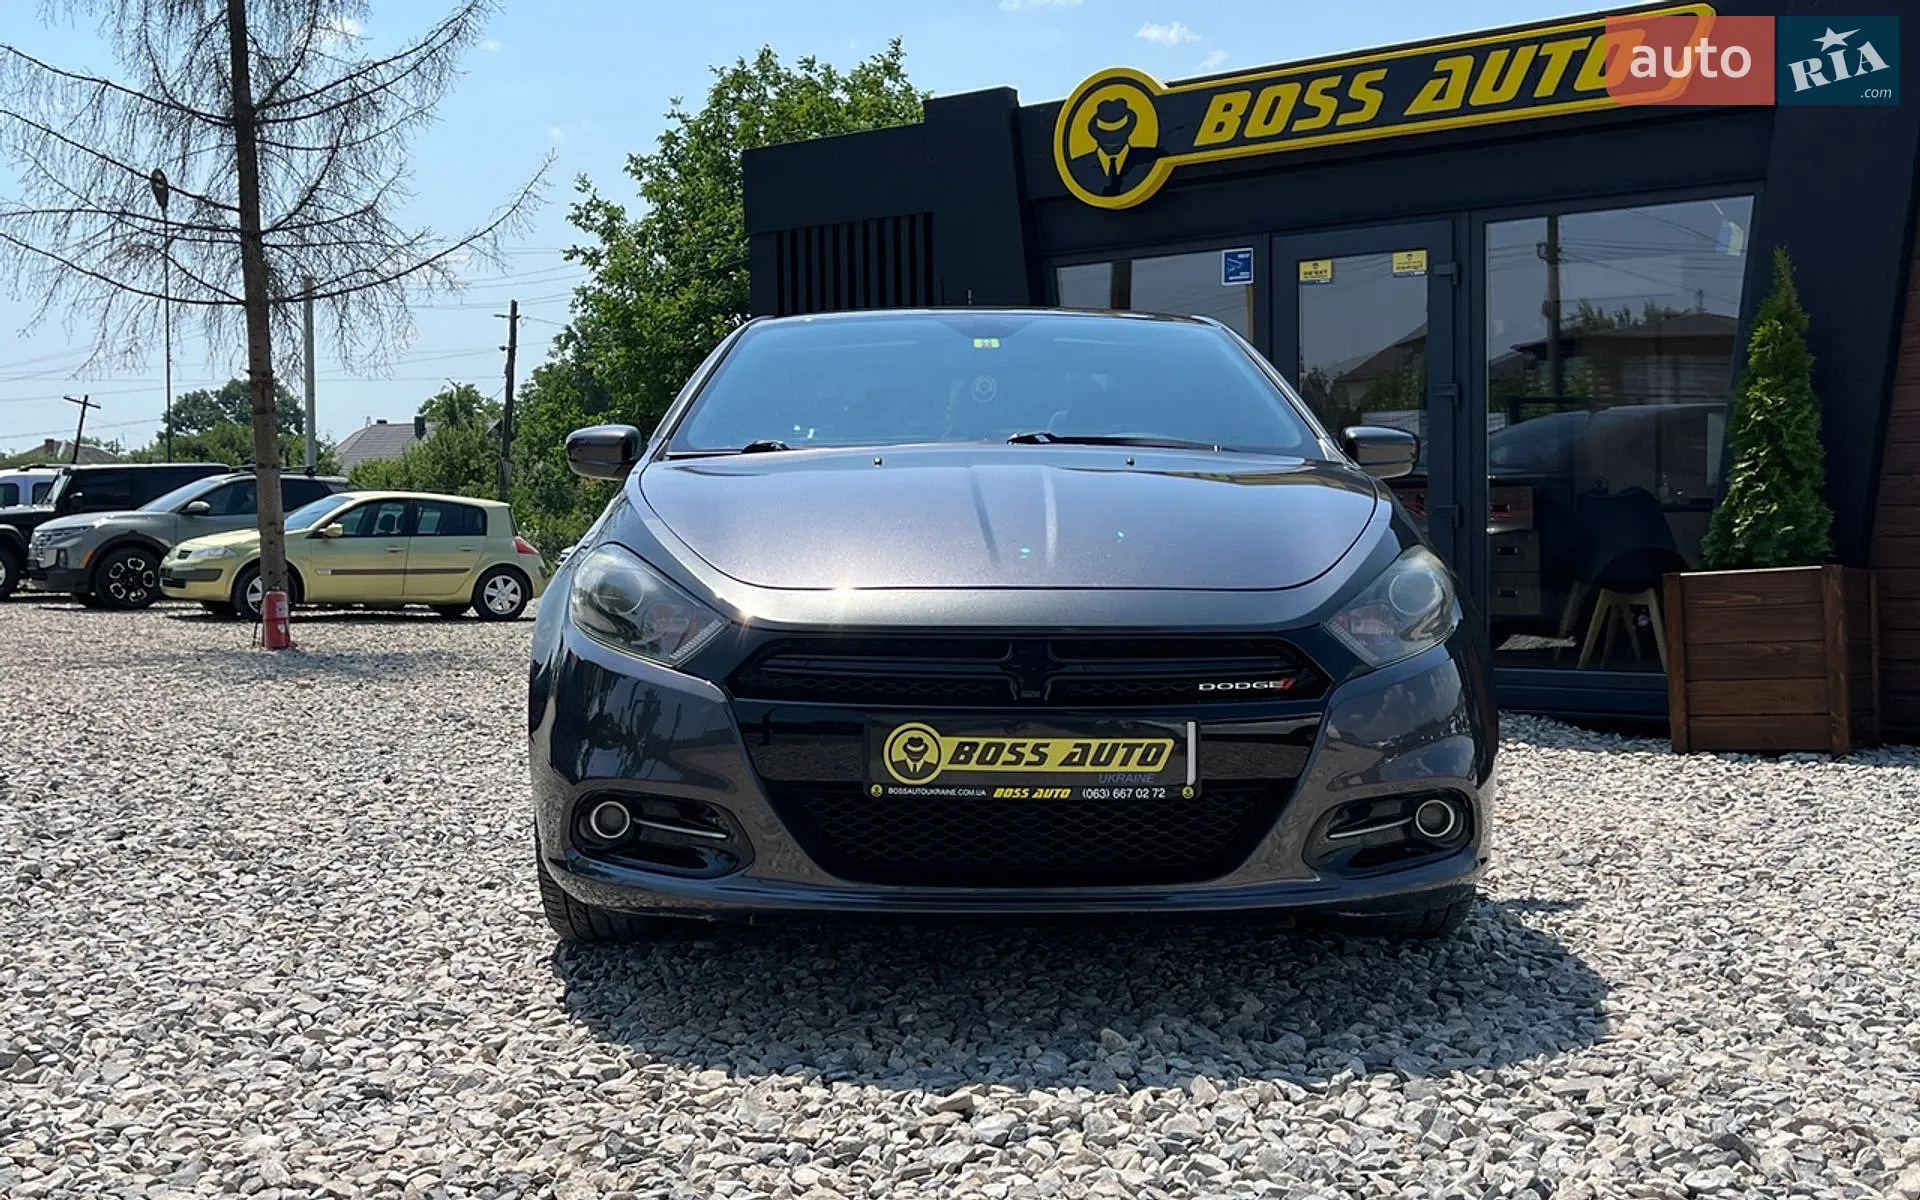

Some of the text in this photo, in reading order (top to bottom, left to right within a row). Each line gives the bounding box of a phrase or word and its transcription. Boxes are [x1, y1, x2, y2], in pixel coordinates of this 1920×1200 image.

[1193, 28, 1646, 147] BOSS AUTO
[1198, 680, 1283, 691] DODGE
[948, 741, 1167, 766] BOSS AUTO
[1099, 773, 1155, 783] UKRAINE
[887, 787, 987, 796] BOSSAUTOUKRAINE.COM.UA
[993, 787, 1071, 799] BOSS AUTO
[1082, 787, 1166, 799] (063) 667 02 72
